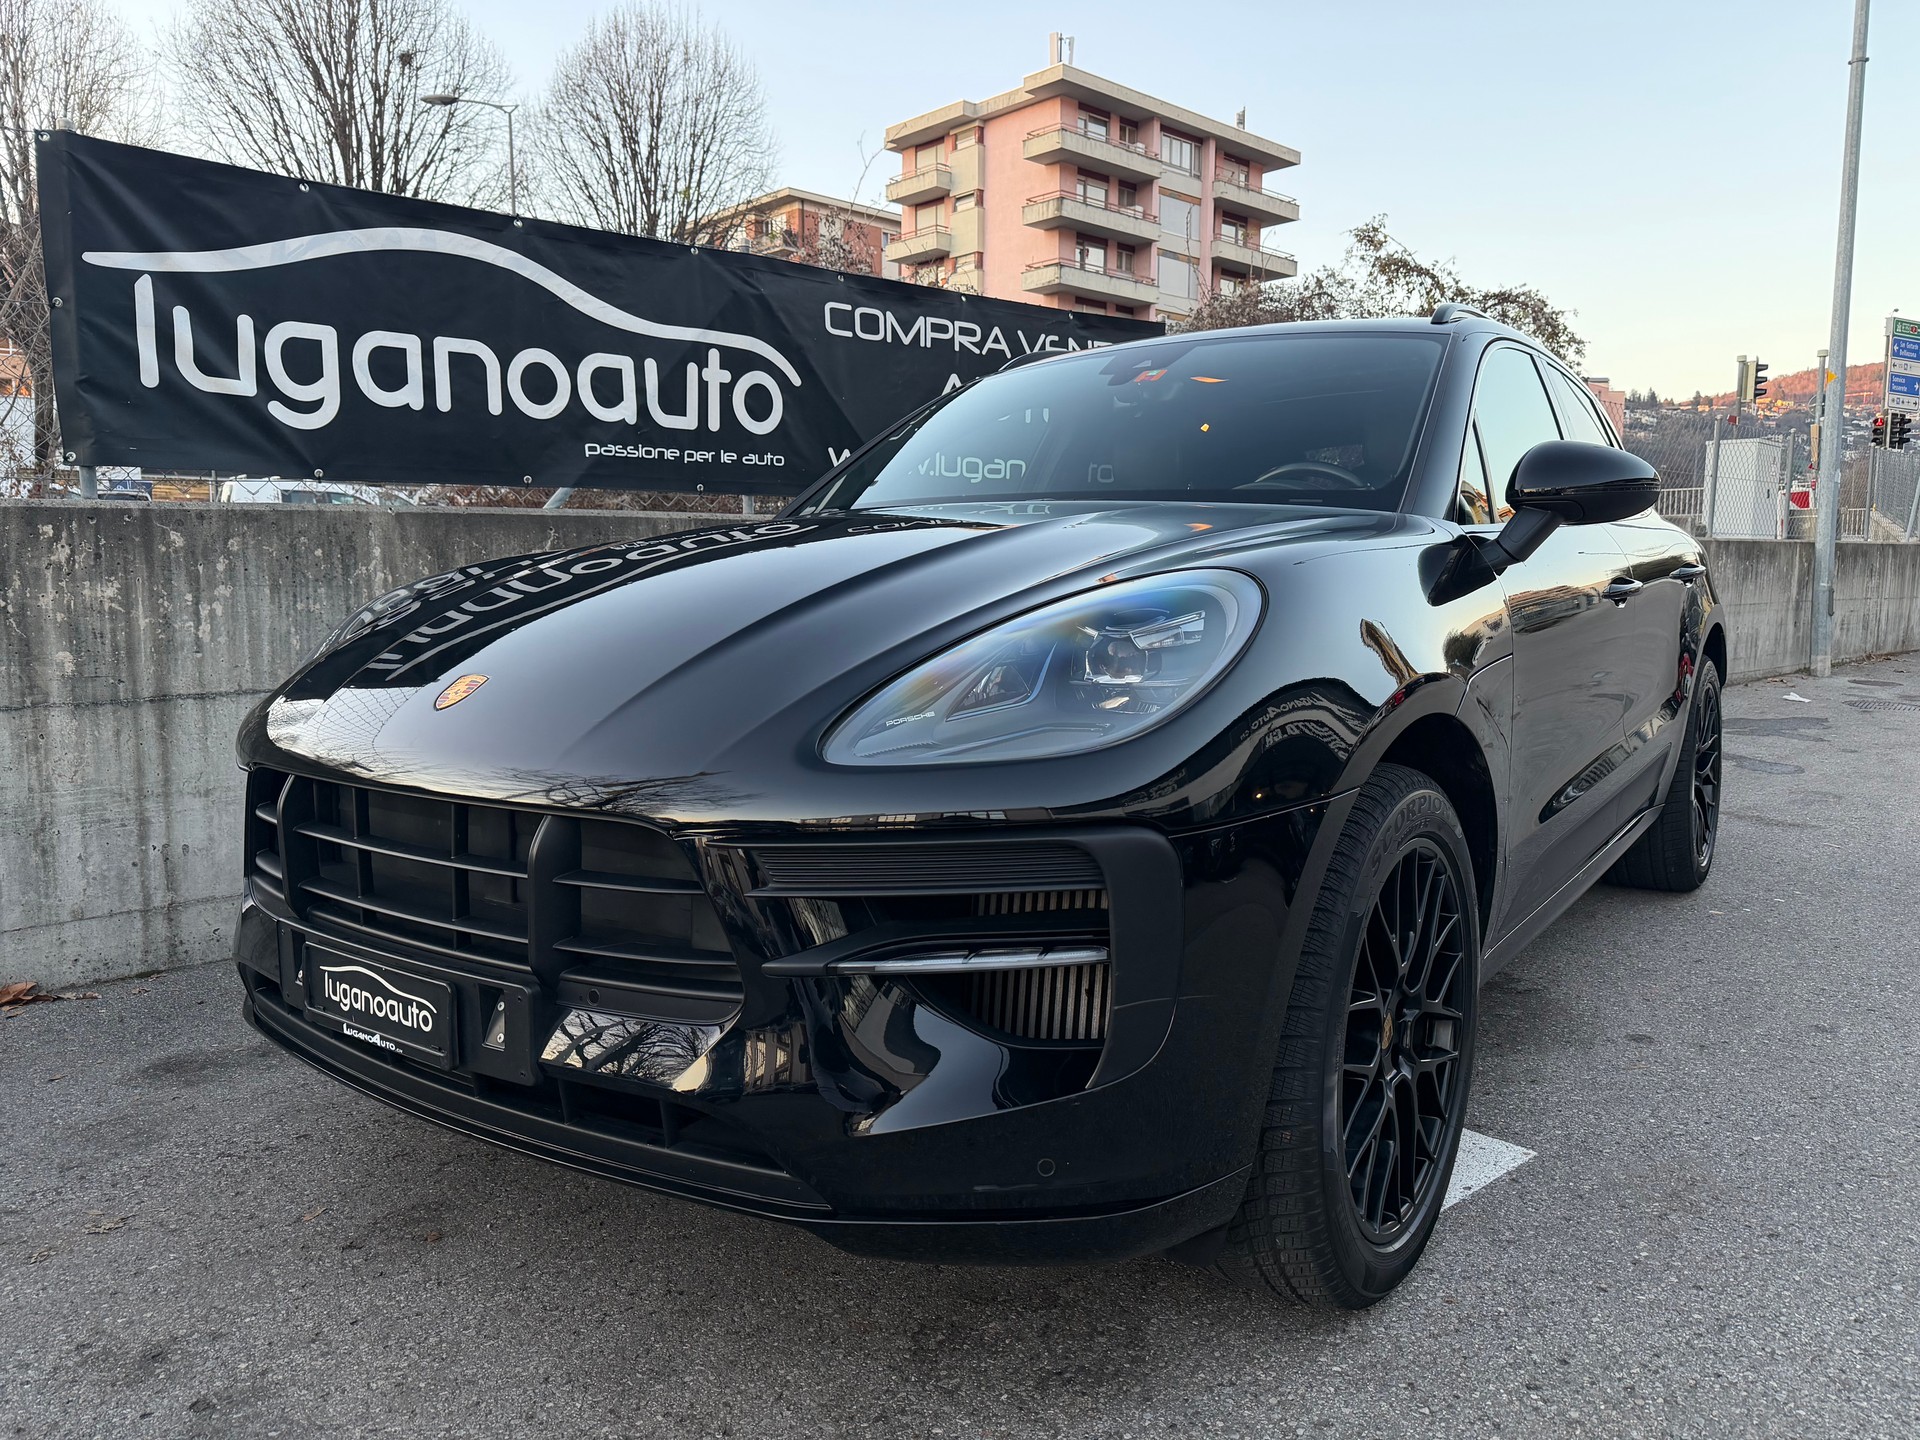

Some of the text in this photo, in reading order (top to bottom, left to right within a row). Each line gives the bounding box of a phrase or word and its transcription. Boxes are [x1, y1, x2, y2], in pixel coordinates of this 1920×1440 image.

[134, 273, 784, 435] luganoauto
[824, 301, 1011, 359] COMPRA
[584, 443, 785, 467] passione per le auto
[885, 710, 936, 727] PORSCHE
[323, 970, 433, 1033] luganoauto
